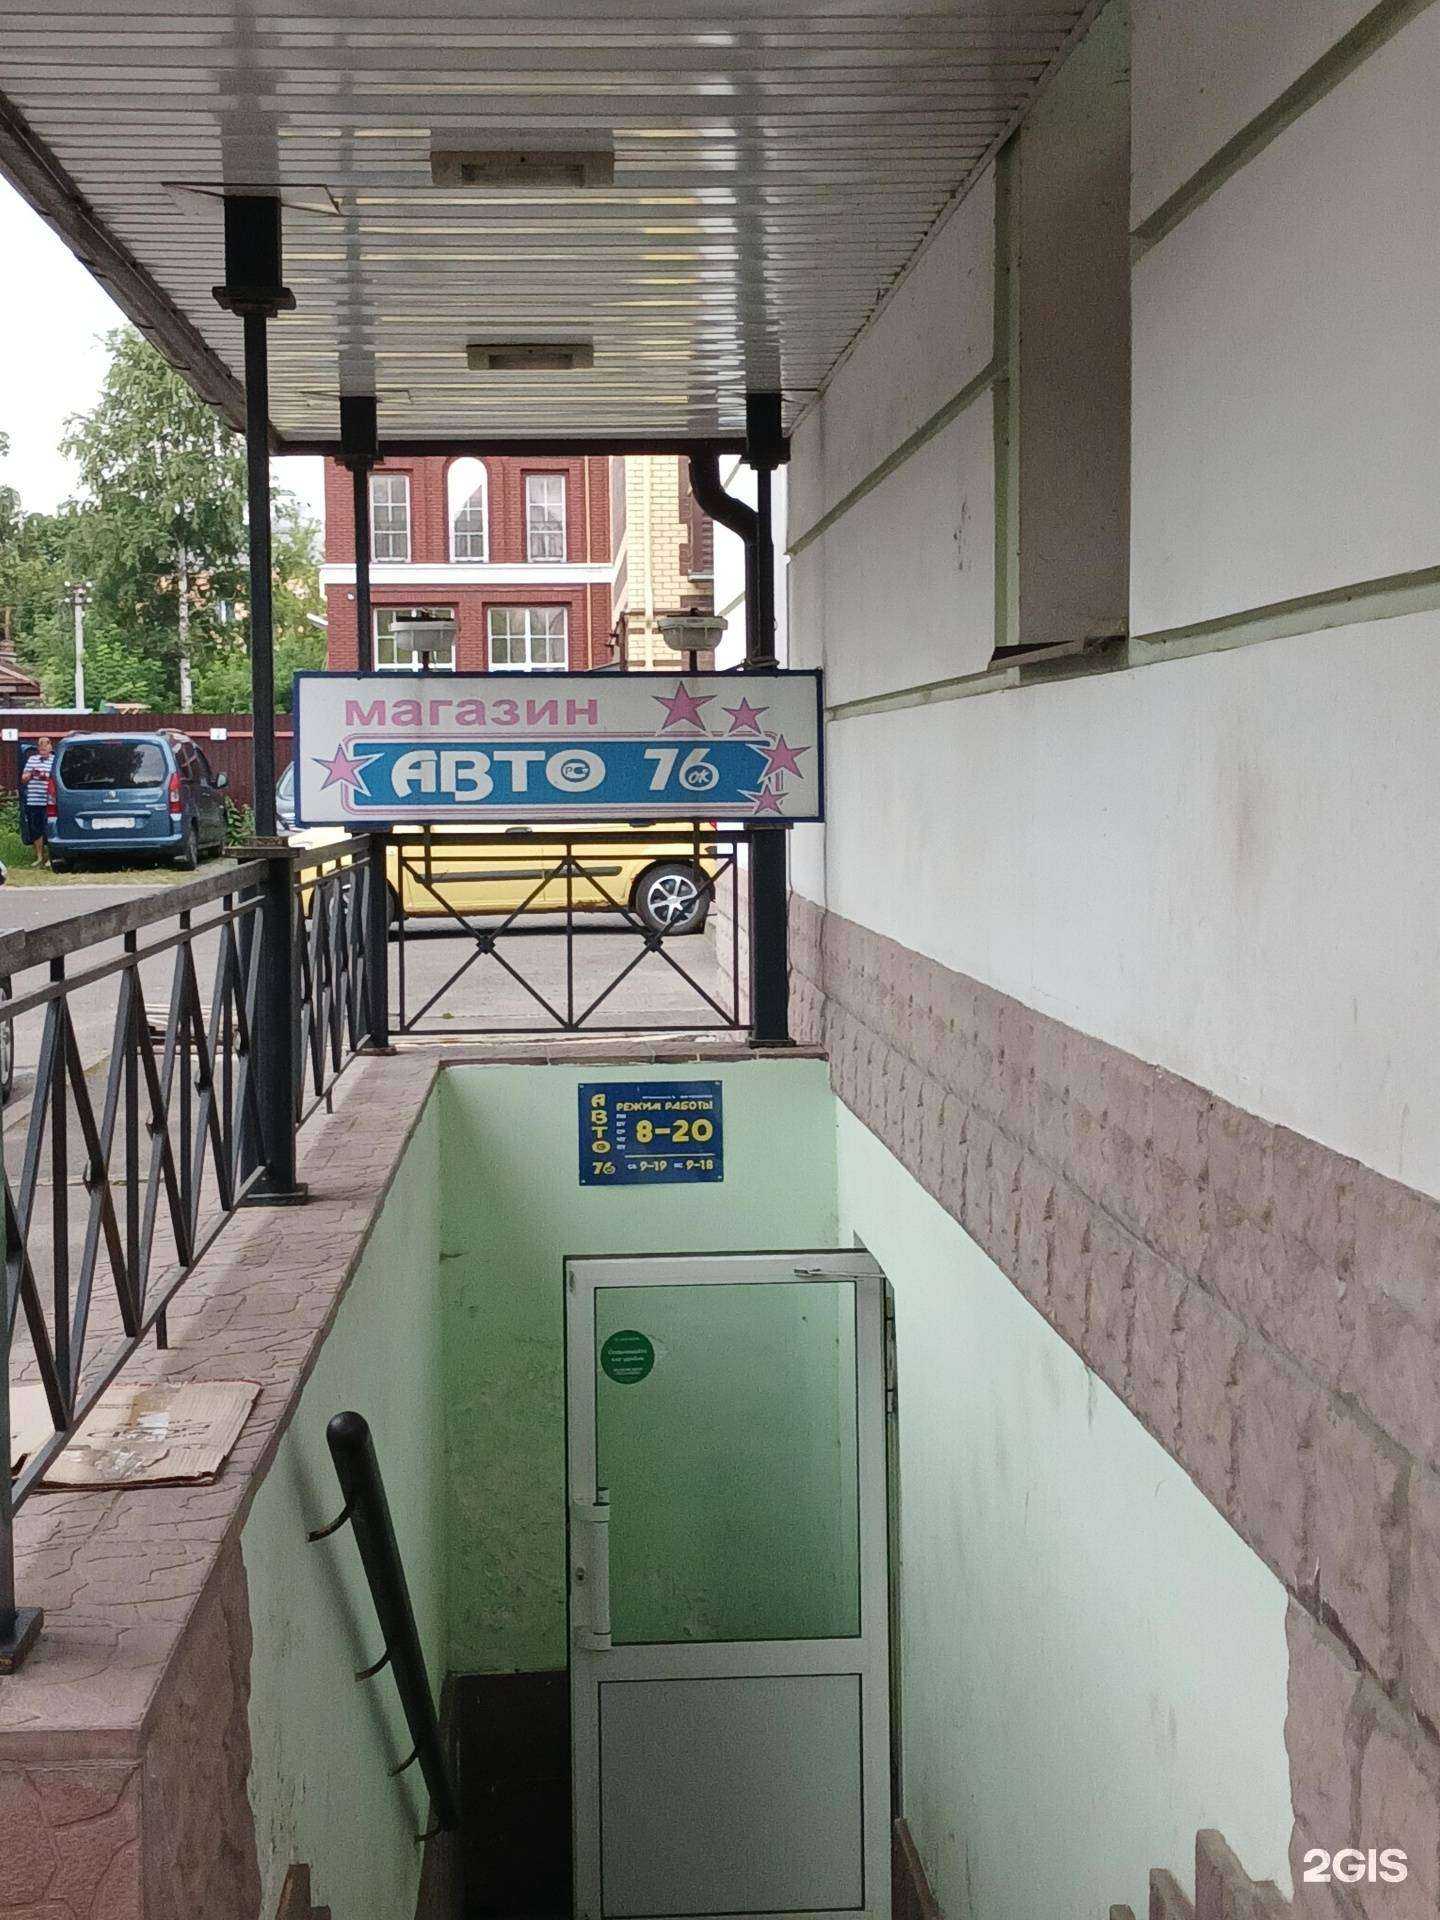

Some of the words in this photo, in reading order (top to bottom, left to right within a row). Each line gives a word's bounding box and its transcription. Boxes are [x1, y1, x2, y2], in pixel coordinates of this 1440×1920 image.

[344, 698, 599, 727] магазин
[390, 749, 607, 802] АВТО
[643, 748, 720, 792] 76
[616, 1102, 662, 1111] РЕЖИМ
[665, 1101, 713, 1110] РАБОТЫ
[636, 1118, 713, 1143] 8-20
[592, 1161, 616, 1175] 76
[640, 1161, 668, 1172] 9-19
[686, 1159, 713, 1170] 9-18
